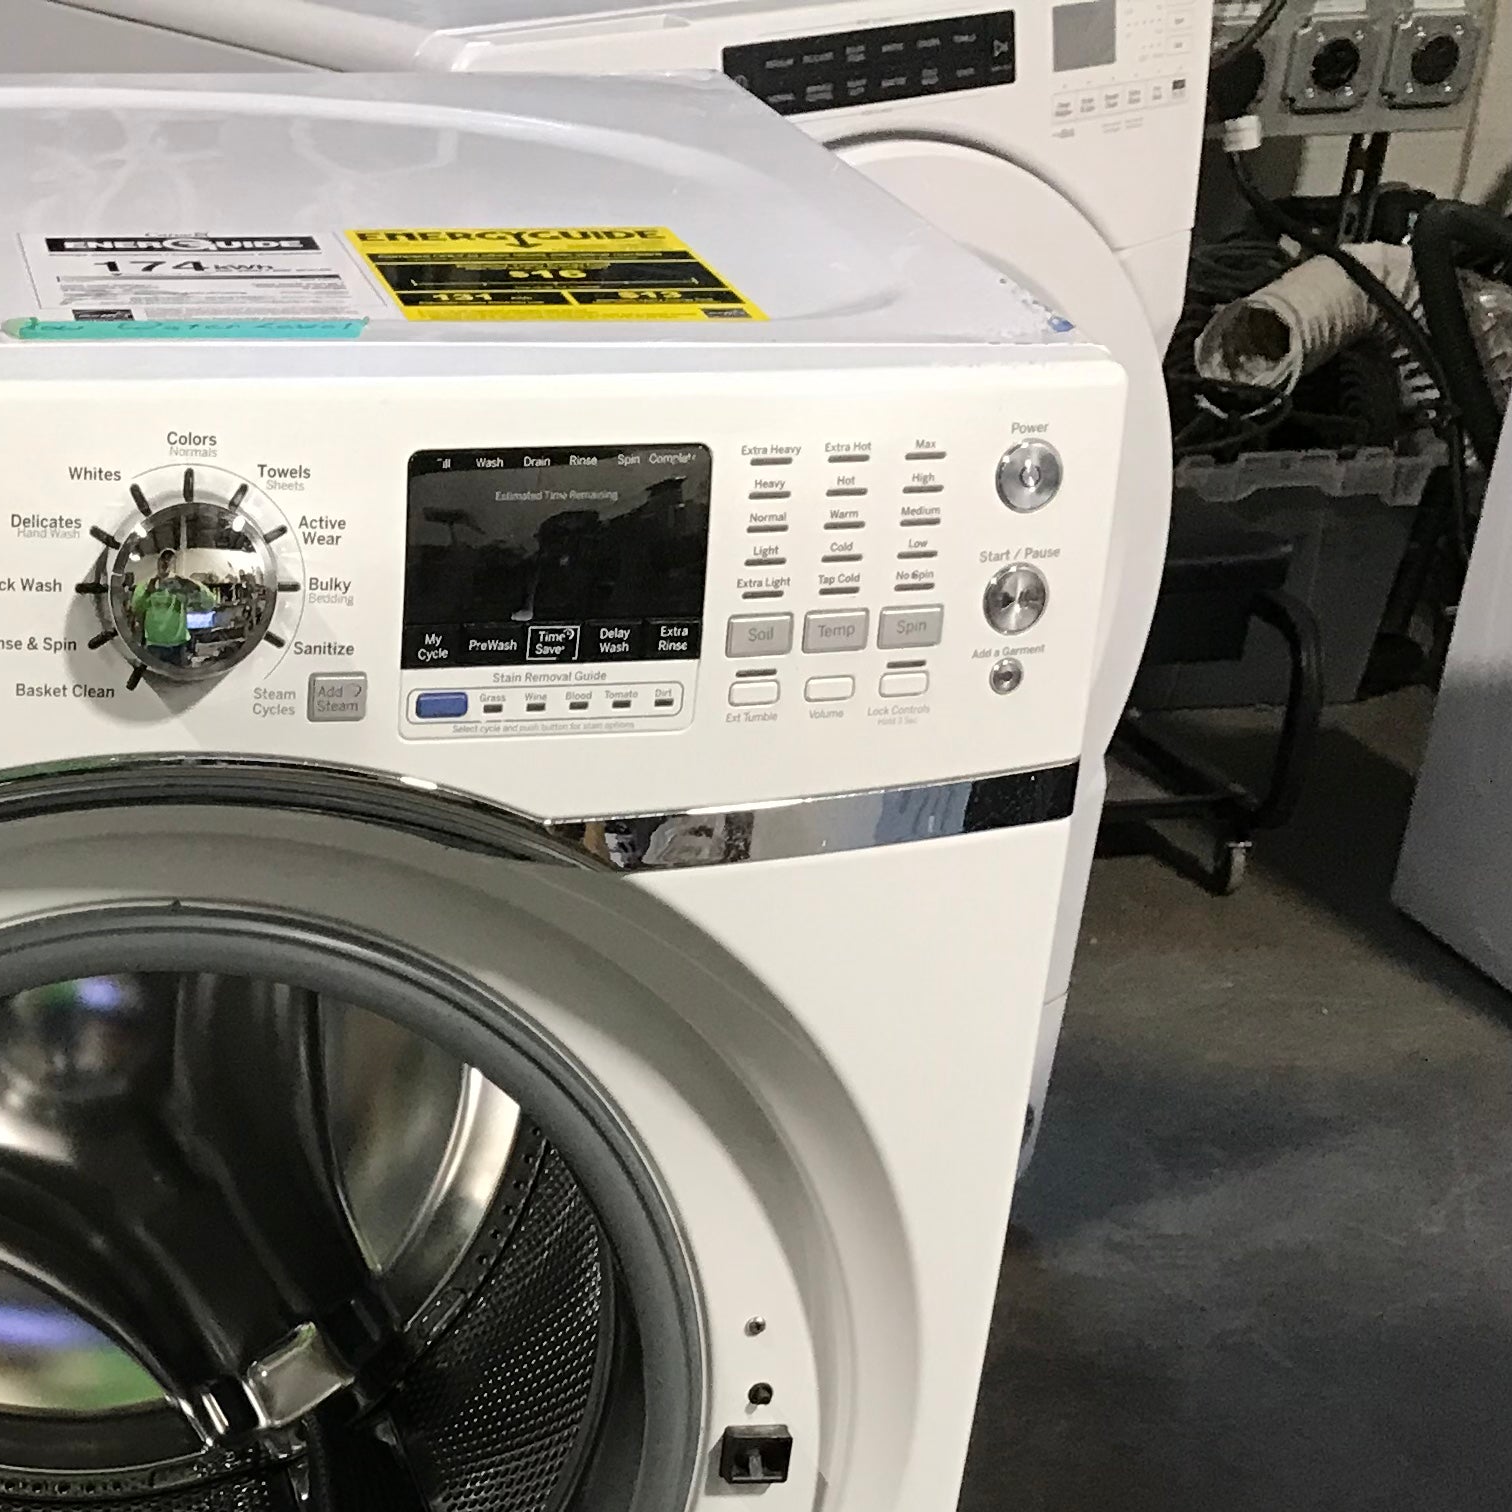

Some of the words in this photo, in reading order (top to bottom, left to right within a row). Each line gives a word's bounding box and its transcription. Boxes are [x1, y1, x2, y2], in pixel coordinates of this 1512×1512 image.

[94, 260, 209, 273] 174
[1011, 422, 1048, 435] Power
[167, 431, 217, 447] Colors
[916, 438, 936, 449] Max
[169, 446, 217, 458] Normals
[741, 445, 768, 456] Extra
[770, 444, 801, 457] Heavy
[824, 442, 850, 452] Extra
[851, 441, 871, 452] Hot
[476, 457, 504, 468] Wash
[524, 456, 550, 467] Drain
[569, 454, 597, 466] Rinse
[617, 454, 640, 467] Spin
[68, 467, 121, 482] Whites
[257, 464, 311, 480] Towels
[754, 479, 785, 490] Heavy
[837, 475, 855, 485] Hot
[912, 473, 935, 484] High
[266, 480, 304, 492] Sheets
[749, 511, 786, 522] Normal
[830, 509, 859, 519] Warm
[901, 505, 941, 516] Medium
[11, 514, 82, 529] Delicates
[299, 516, 346, 530] Active
[48, 528, 80, 539] Wash
[302, 531, 341, 546] Wear
[830, 542, 853, 552] Cold
[908, 539, 928, 548] Low
[753, 545, 779, 557] Light
[979, 550, 1012, 563] Start
[1024, 547, 1060, 560] Pause
[818, 574, 835, 586] Tap
[837, 573, 860, 584] Cold
[896, 571, 910, 581] No
[20, 578, 62, 593] Wash
[309, 577, 351, 593] Bulky
[737, 578, 764, 588] Extra
[766, 577, 791, 588] Light
[308, 593, 354, 606] Bedding
[600, 627, 630, 640] Delay
[660, 625, 688, 637] Extra
[817, 624, 855, 639] Temp
[896, 619, 927, 636] Spin
[425, 634, 442, 646] My
[539, 631, 565, 643] Time
[748, 628, 774, 641] Soil
[27, 637, 38, 650] &
[42, 637, 77, 655] Spin
[293, 641, 355, 656] Sanitize
[469, 639, 518, 651] PreWash
[599, 641, 629, 653] Wash
[658, 639, 688, 651] Rinse
[418, 648, 448, 661] Cycle
[972, 648, 990, 659] Add
[1001, 644, 1045, 656] Garment
[492, 673, 522, 683] Stain
[524, 671, 572, 682] Removal
[574, 671, 607, 681] Guide
[15, 684, 68, 698] Basket
[72, 684, 115, 699] Clean
[253, 688, 296, 700] Steam
[317, 686, 344, 698] Add
[479, 693, 506, 702] Grass
[524, 692, 547, 701] Wine
[565, 691, 592, 700] Blood
[605, 690, 638, 699] Tomato
[655, 688, 672, 698] Dirt
[252, 702, 295, 717] Cycles
[317, 700, 359, 713] Steam
[867, 707, 890, 716] Lock
[892, 704, 930, 715] Controls
[725, 712, 742, 722] Ext
[744, 711, 778, 722] Tumble
[809, 709, 844, 719] Volume
